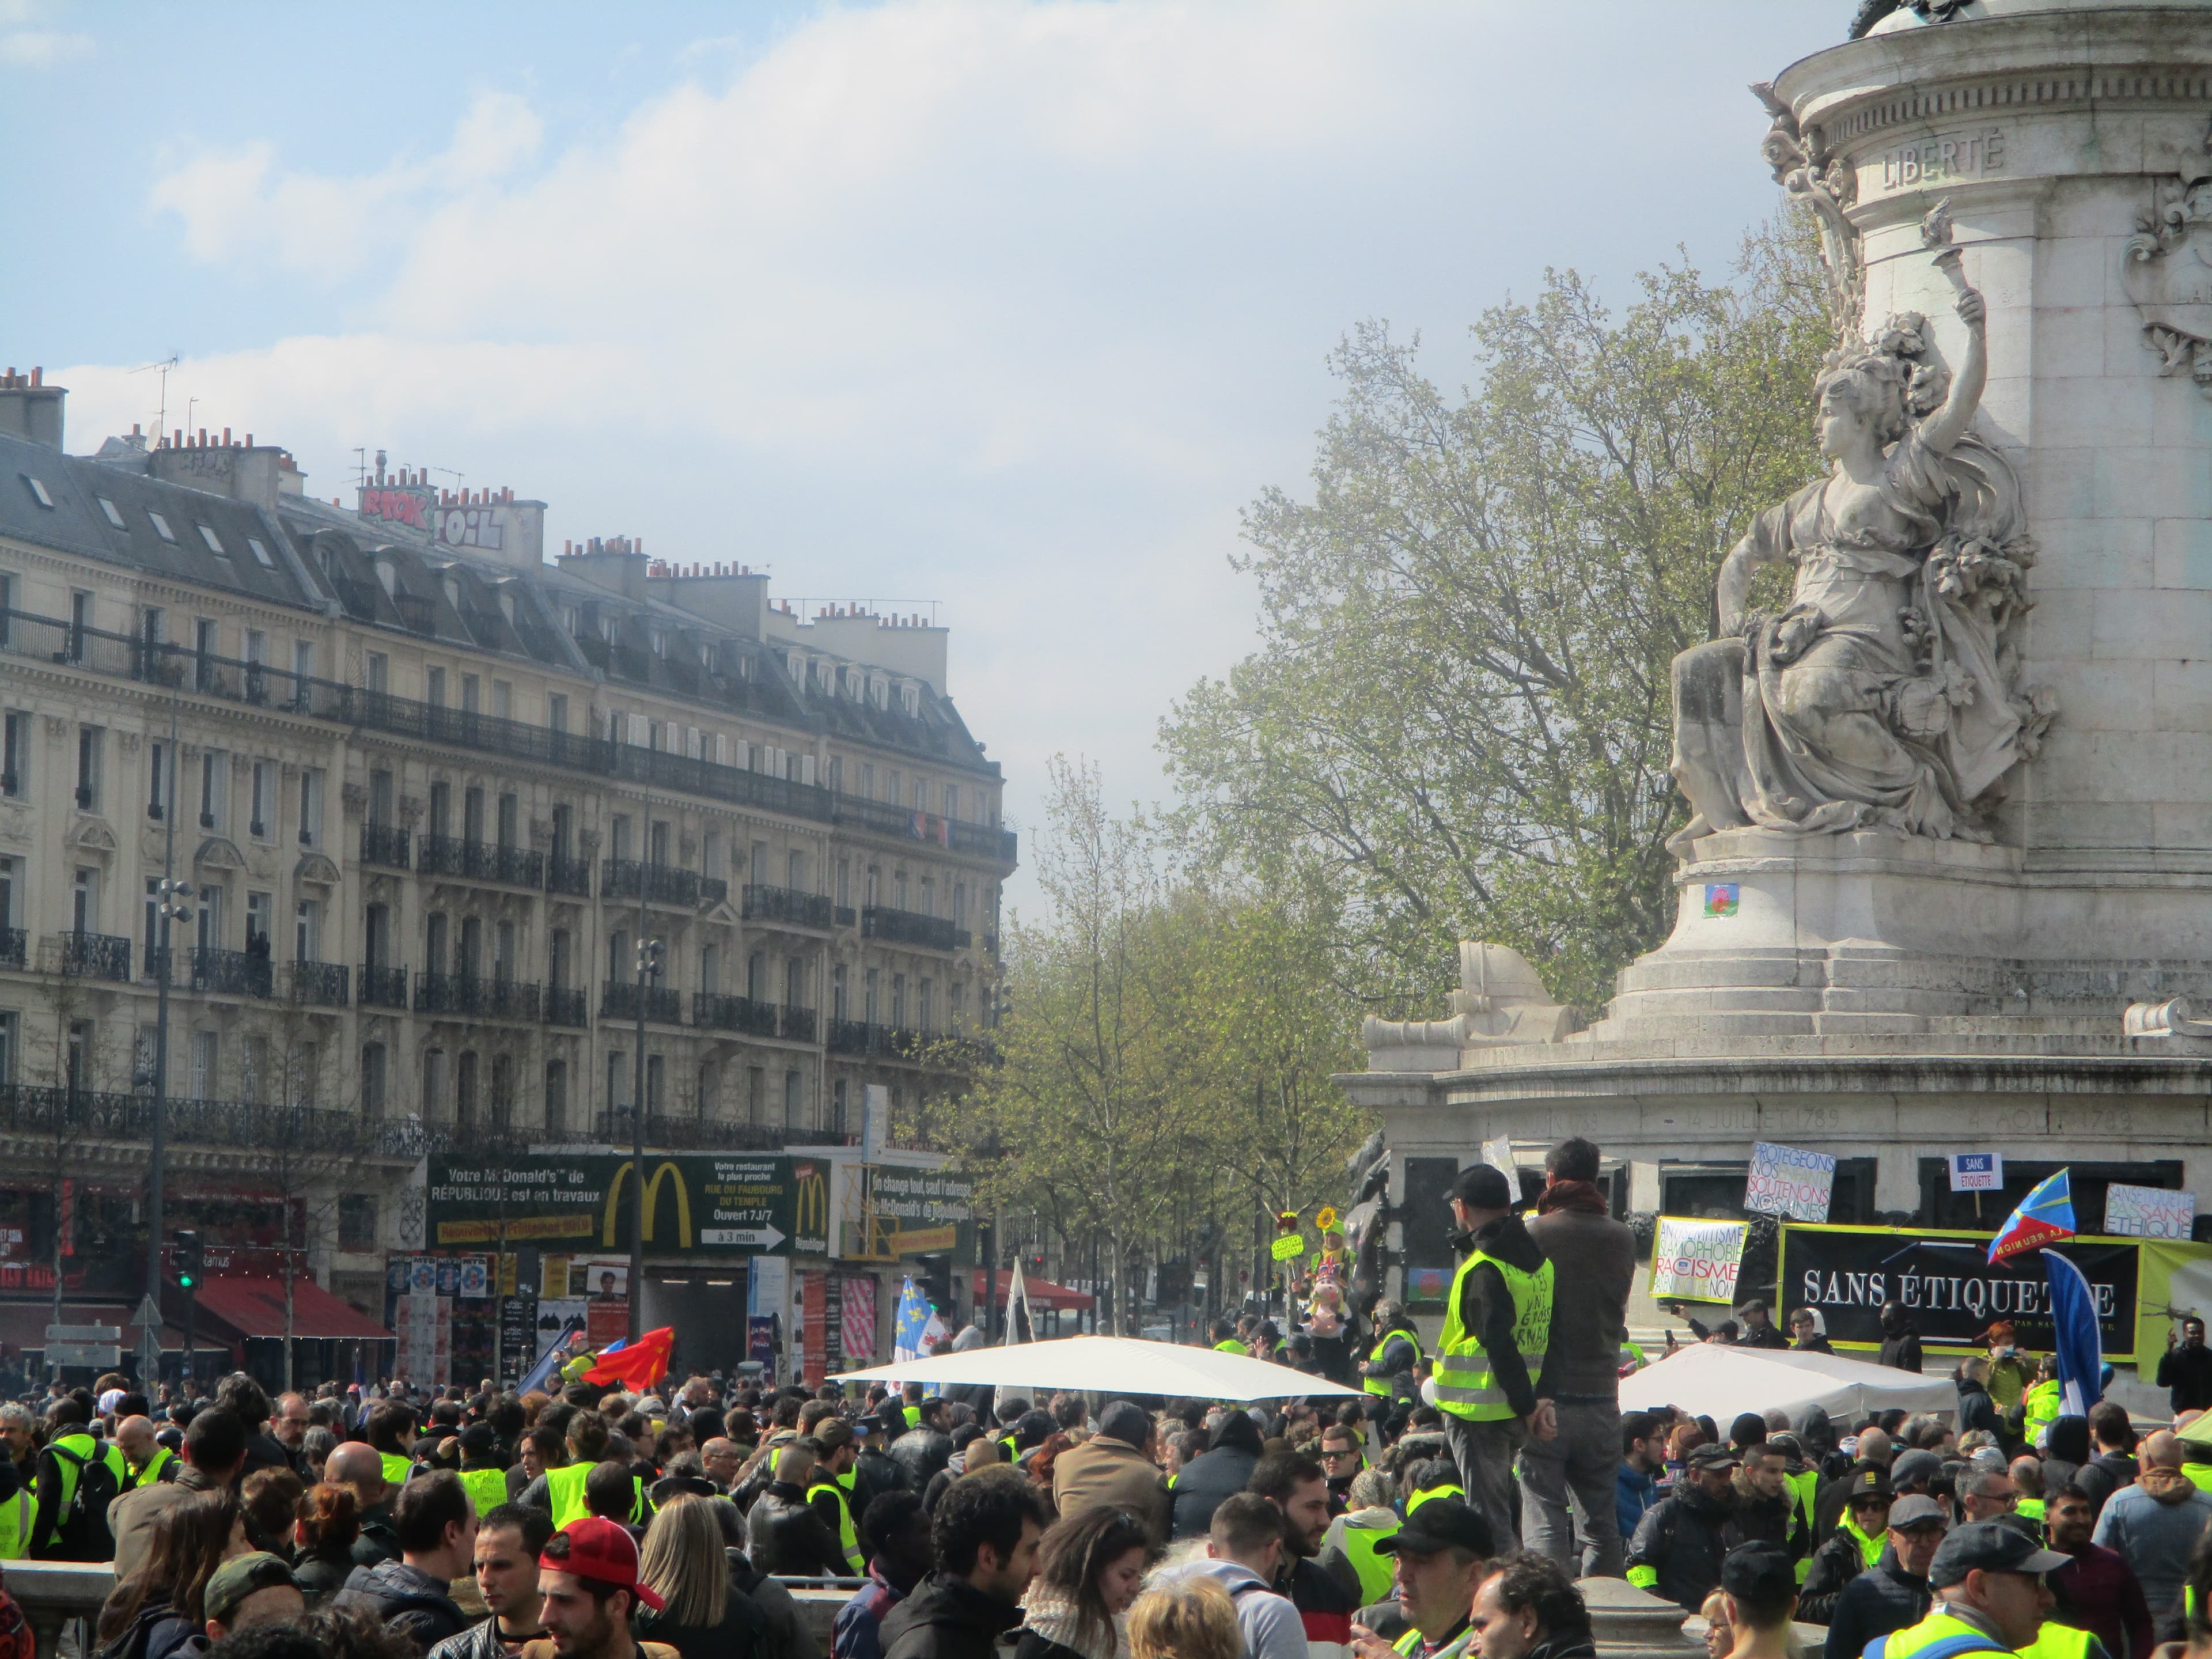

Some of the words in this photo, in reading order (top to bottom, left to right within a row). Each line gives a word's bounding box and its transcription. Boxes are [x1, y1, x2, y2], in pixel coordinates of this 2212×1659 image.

[1756, 1142, 1835, 1173] PROTEGEONS
[1966, 1157, 1984, 1170] SANS
[715, 1162, 734, 1171] Votre
[736, 1162, 775, 1171] restaurant
[1750, 1161, 1779, 1179] NOS
[449, 1168, 480, 1182] Votre
[568, 1169, 584, 1184] de
[726, 1173, 743, 1182] plus
[744, 1173, 771, 1182] proche
[704, 1185, 720, 1194] RUE
[724, 1185, 736, 1194] DU
[738, 1185, 783, 1195] FAUBOURG
[884, 1175, 909, 1196] change
[926, 1178, 940, 1195] sauf
[1748, 1175, 1830, 1205] SOUTENONS
[512, 1188, 531, 1202] est
[534, 1190, 548, 1202] en
[552, 1188, 600, 1202] travaux
[720, 1197, 732, 1206] DU
[734, 1197, 767, 1207] TEMPLE
[714, 1209, 747, 1221] Ouvert
[750, 1210, 772, 1221] 7J/7
[923, 1202, 932, 1218] de
[2139, 1203, 2192, 1225] SANS
[2106, 1215, 2191, 1240] ETHIQUE
[718, 1233, 724, 1243] à
[726, 1232, 733, 1243] 3
[736, 1232, 755, 1243] min
[1658, 1239, 1742, 1263] ISLAMOPHOBIE
[1654, 1257, 1740, 1281] RACISME
[1710, 1279, 1734, 1299] NOM
[1804, 1269, 1886, 1306] SANS
[1898, 1265, 2115, 1320] ÉTIQUETE
